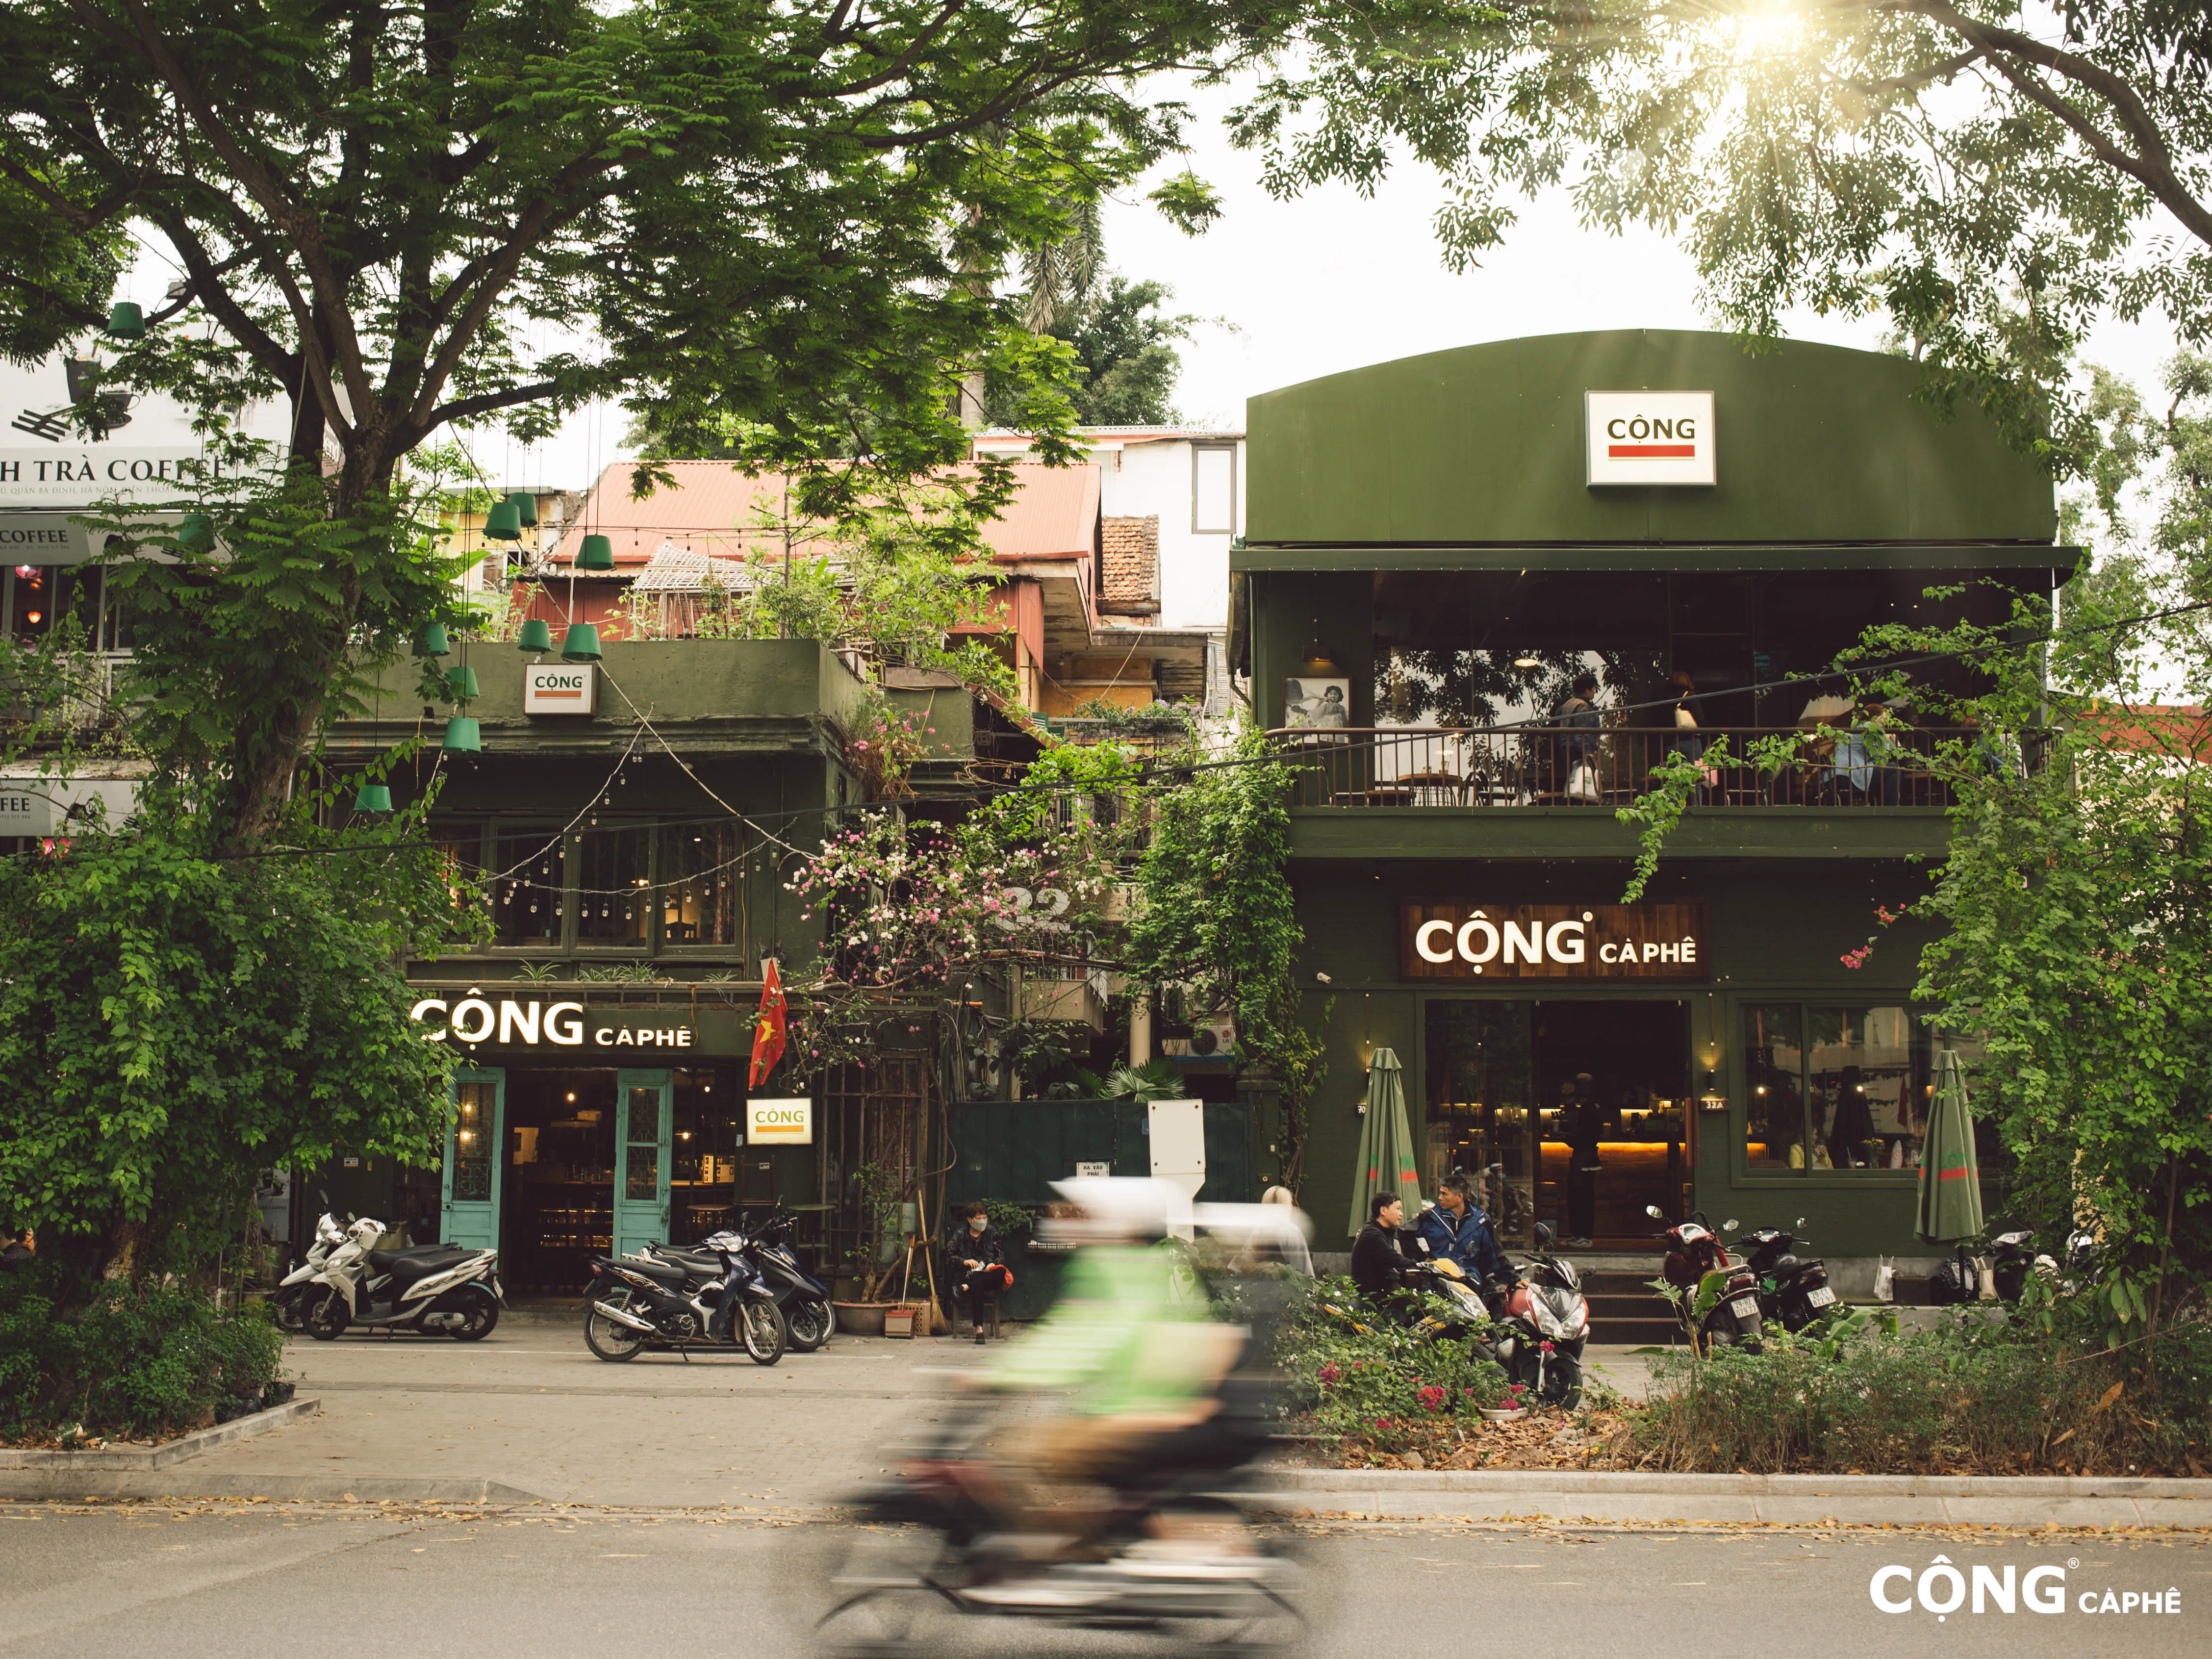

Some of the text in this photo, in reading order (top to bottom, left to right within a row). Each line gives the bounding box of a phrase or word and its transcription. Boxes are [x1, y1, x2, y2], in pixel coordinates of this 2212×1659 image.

[1607, 414, 1695, 443] CỘNG
[33, 454, 97, 482] TRÀ
[0, 530, 68, 543] COFFEE
[535, 674, 583, 690] CỘNG
[1416, 910, 1584, 974] CỘNG
[410, 987, 583, 1050] CỘNG
